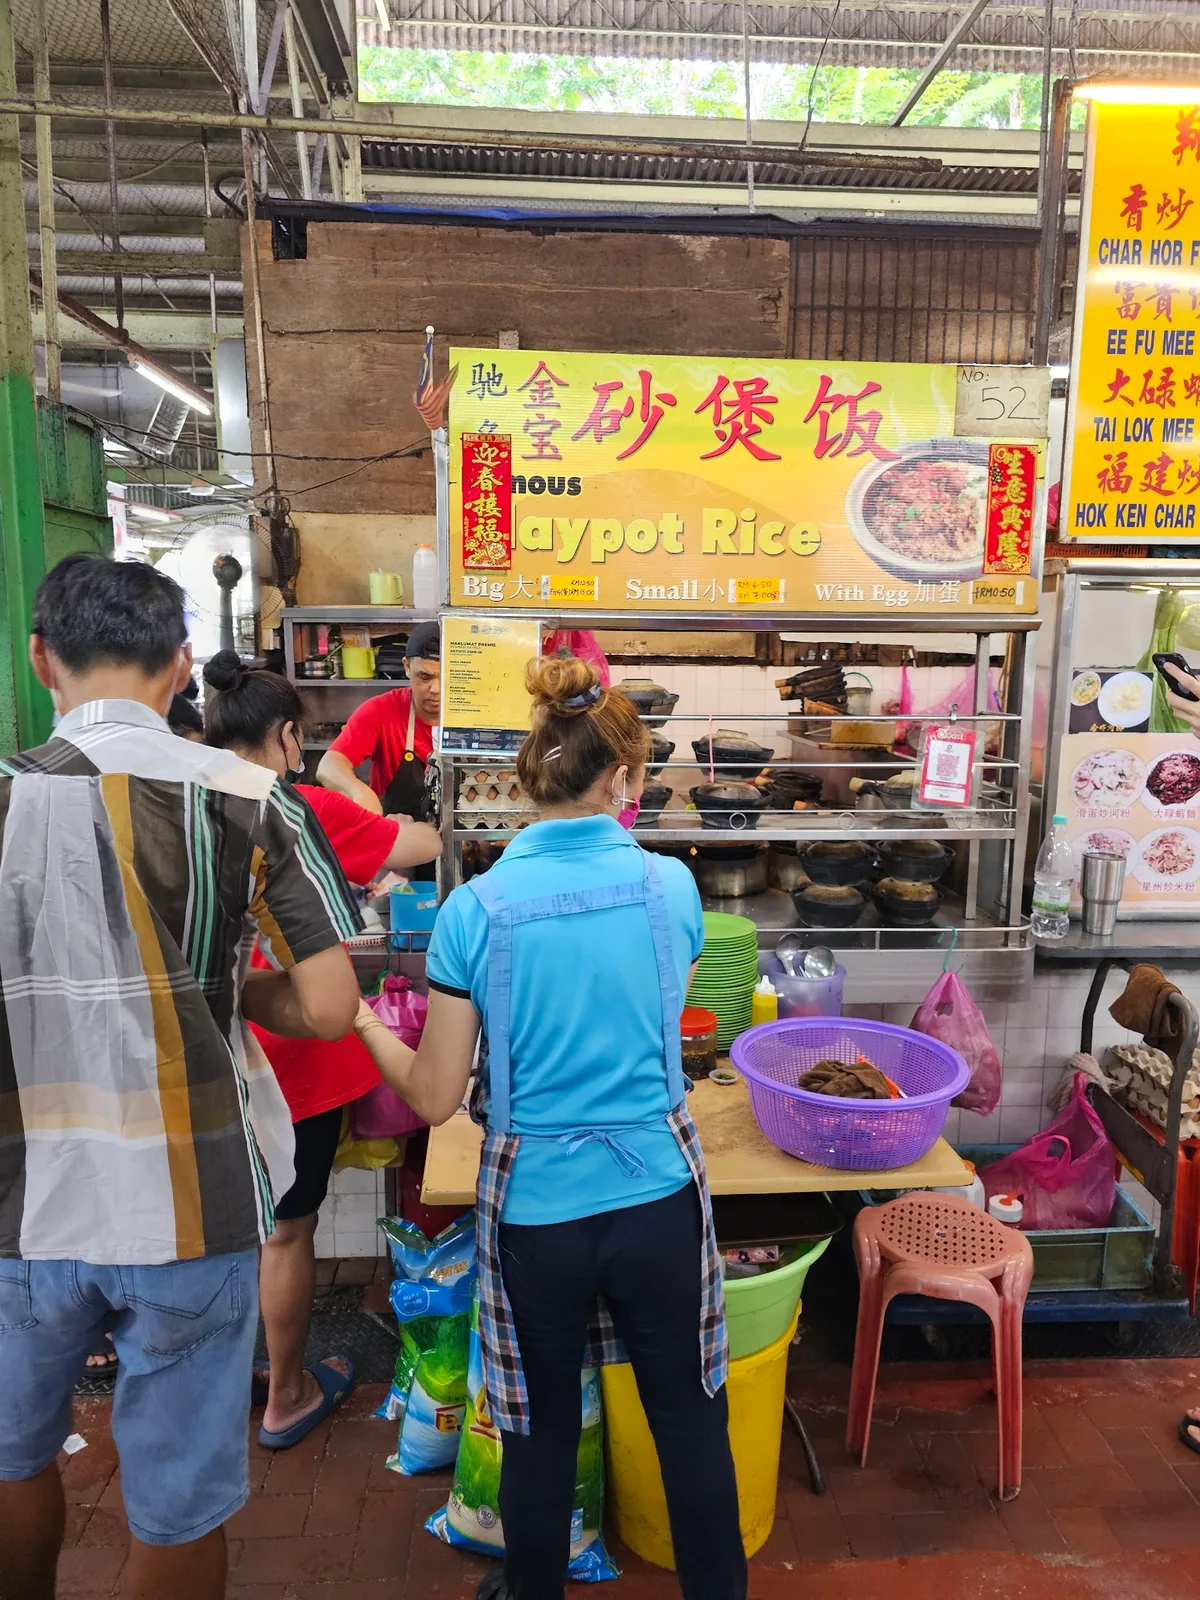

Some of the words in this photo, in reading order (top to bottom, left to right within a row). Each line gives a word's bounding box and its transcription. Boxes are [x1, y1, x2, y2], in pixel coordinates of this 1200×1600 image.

[1120, 184, 1194, 232] 香炒
[1098, 238, 1142, 265] CHAR
[1150, 239, 1183, 266] HOR
[1106, 329, 1128, 355] EE
[1134, 329, 1156, 356] FU
[1162, 330, 1196, 356] MEE
[517, 360, 569, 460] 金宝
[570, 369, 903, 461] 砂煲饭
[976, 386, 1040, 421] 52
[1094, 417, 1117, 442] TAI
[1123, 417, 1155, 442] LOK
[1162, 418, 1195, 443] MEE
[471, 442, 503, 543] 迎春接福
[511, 475, 582, 496] mous
[996, 449, 1028, 561] 生意興隆
[1076, 503, 1108, 528] HOK
[1116, 503, 1147, 528] KEN
[1154, 503, 1196, 528] CHAR
[511, 504, 684, 563] aypot
[702, 508, 822, 556] Rice
[462, 575, 505, 602] Big
[509, 574, 534, 600] 大
[626, 578, 700, 601] Small
[702, 578, 725, 603] 小
[814, 583, 865, 602] With
[870, 584, 909, 607] Egg
[913, 579, 962, 605] 加蛋
